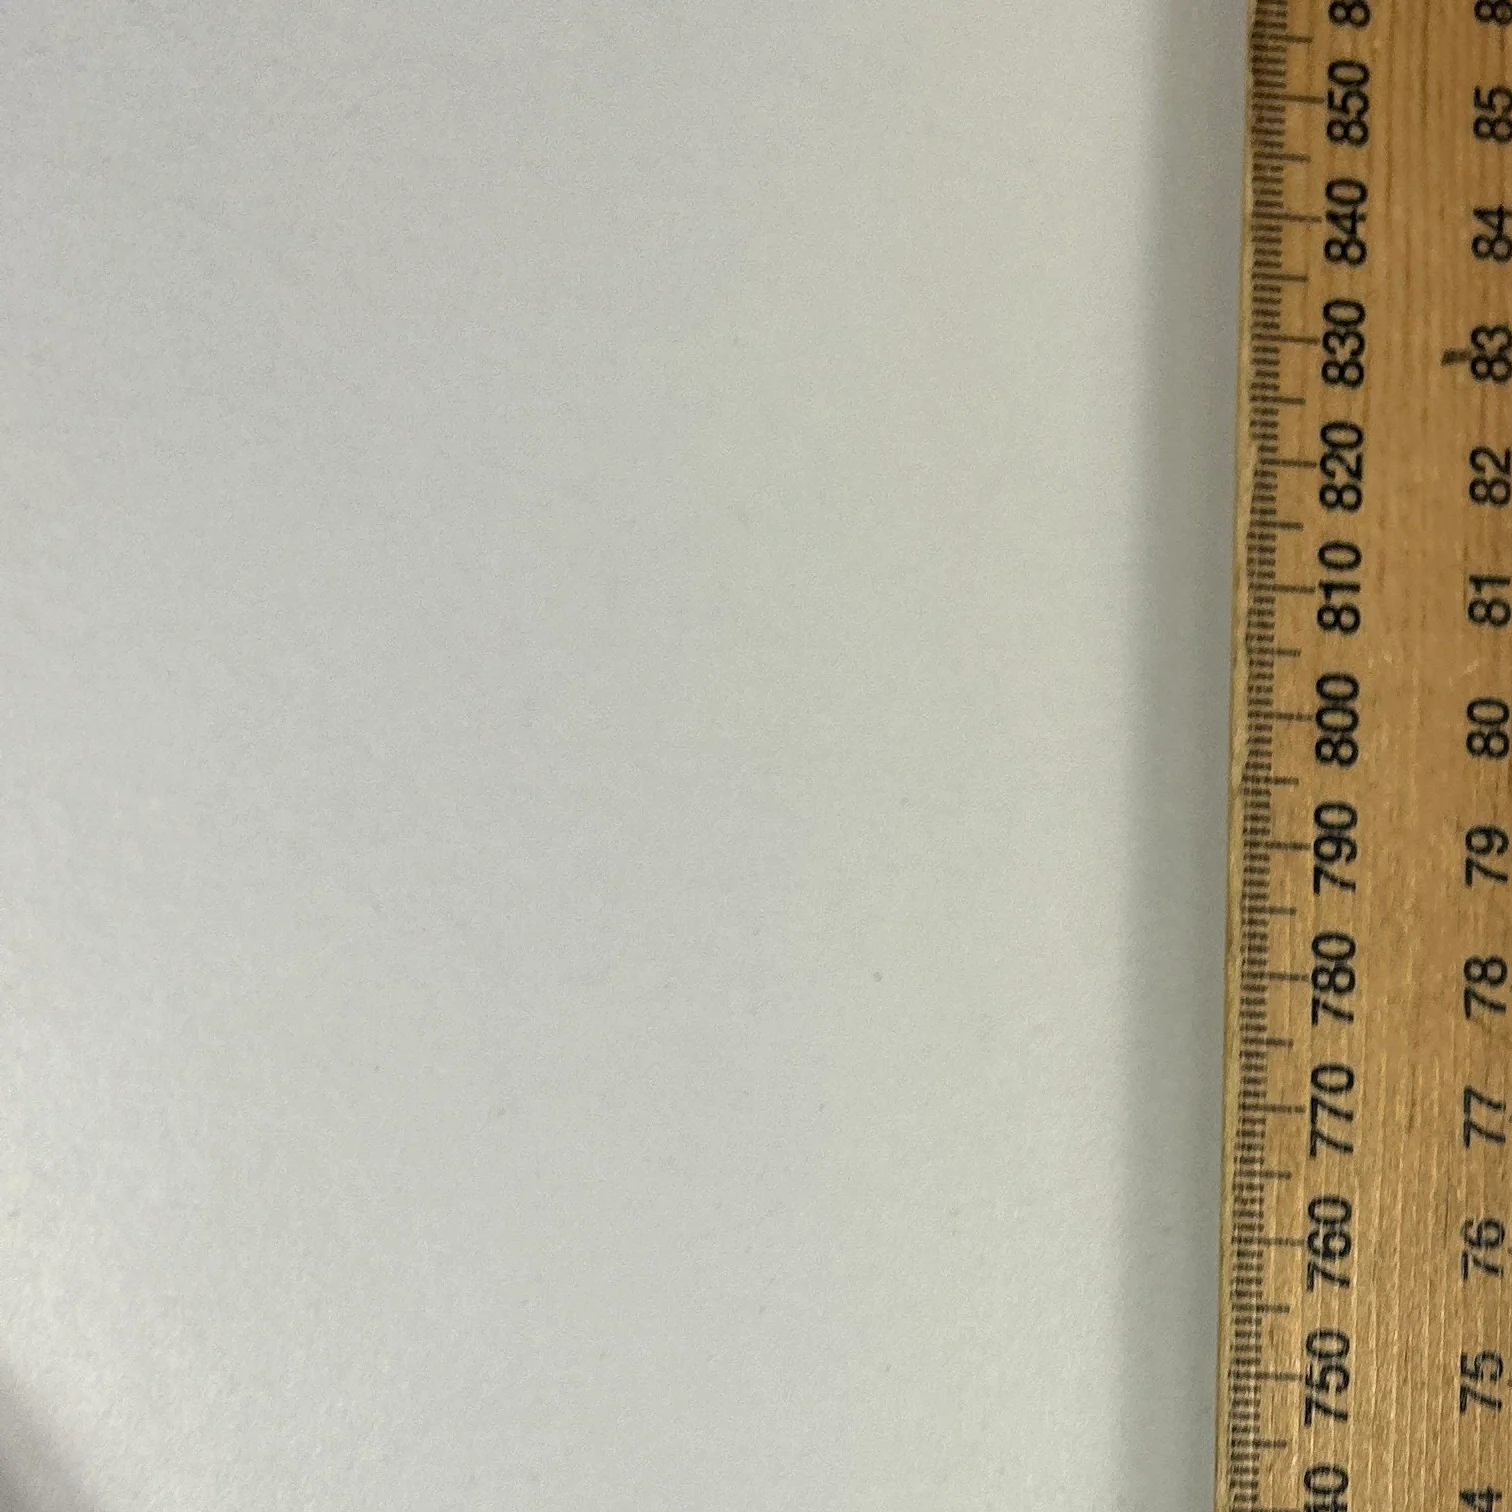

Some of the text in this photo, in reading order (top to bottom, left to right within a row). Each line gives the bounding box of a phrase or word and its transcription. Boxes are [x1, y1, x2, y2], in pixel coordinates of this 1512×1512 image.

[1327, 60, 1370, 146] 850
[1324, 178, 1368, 266] 840
[1322, 299, 1365, 389] 830
[1470, 325, 1512, 383] 83
[1319, 421, 1363, 512] 820
[1469, 447, 1511, 507] 82
[1316, 541, 1361, 634] 810
[1468, 575, 1511, 627] 81
[1315, 674, 1359, 766] 800
[1466, 698, 1509, 759] 80
[1314, 803, 1357, 896] 790
[1466, 827, 1509, 887] 79
[1311, 932, 1355, 1025] 780
[1464, 956, 1507, 1019] 78
[1310, 1063, 1354, 1158] 770
[1464, 1086, 1506, 1148] 77
[1307, 1197, 1351, 1290] 760
[1462, 1219, 1505, 1280] 76
[1304, 1330, 1349, 1426] 750
[1460, 1352, 1503, 1413] 75
